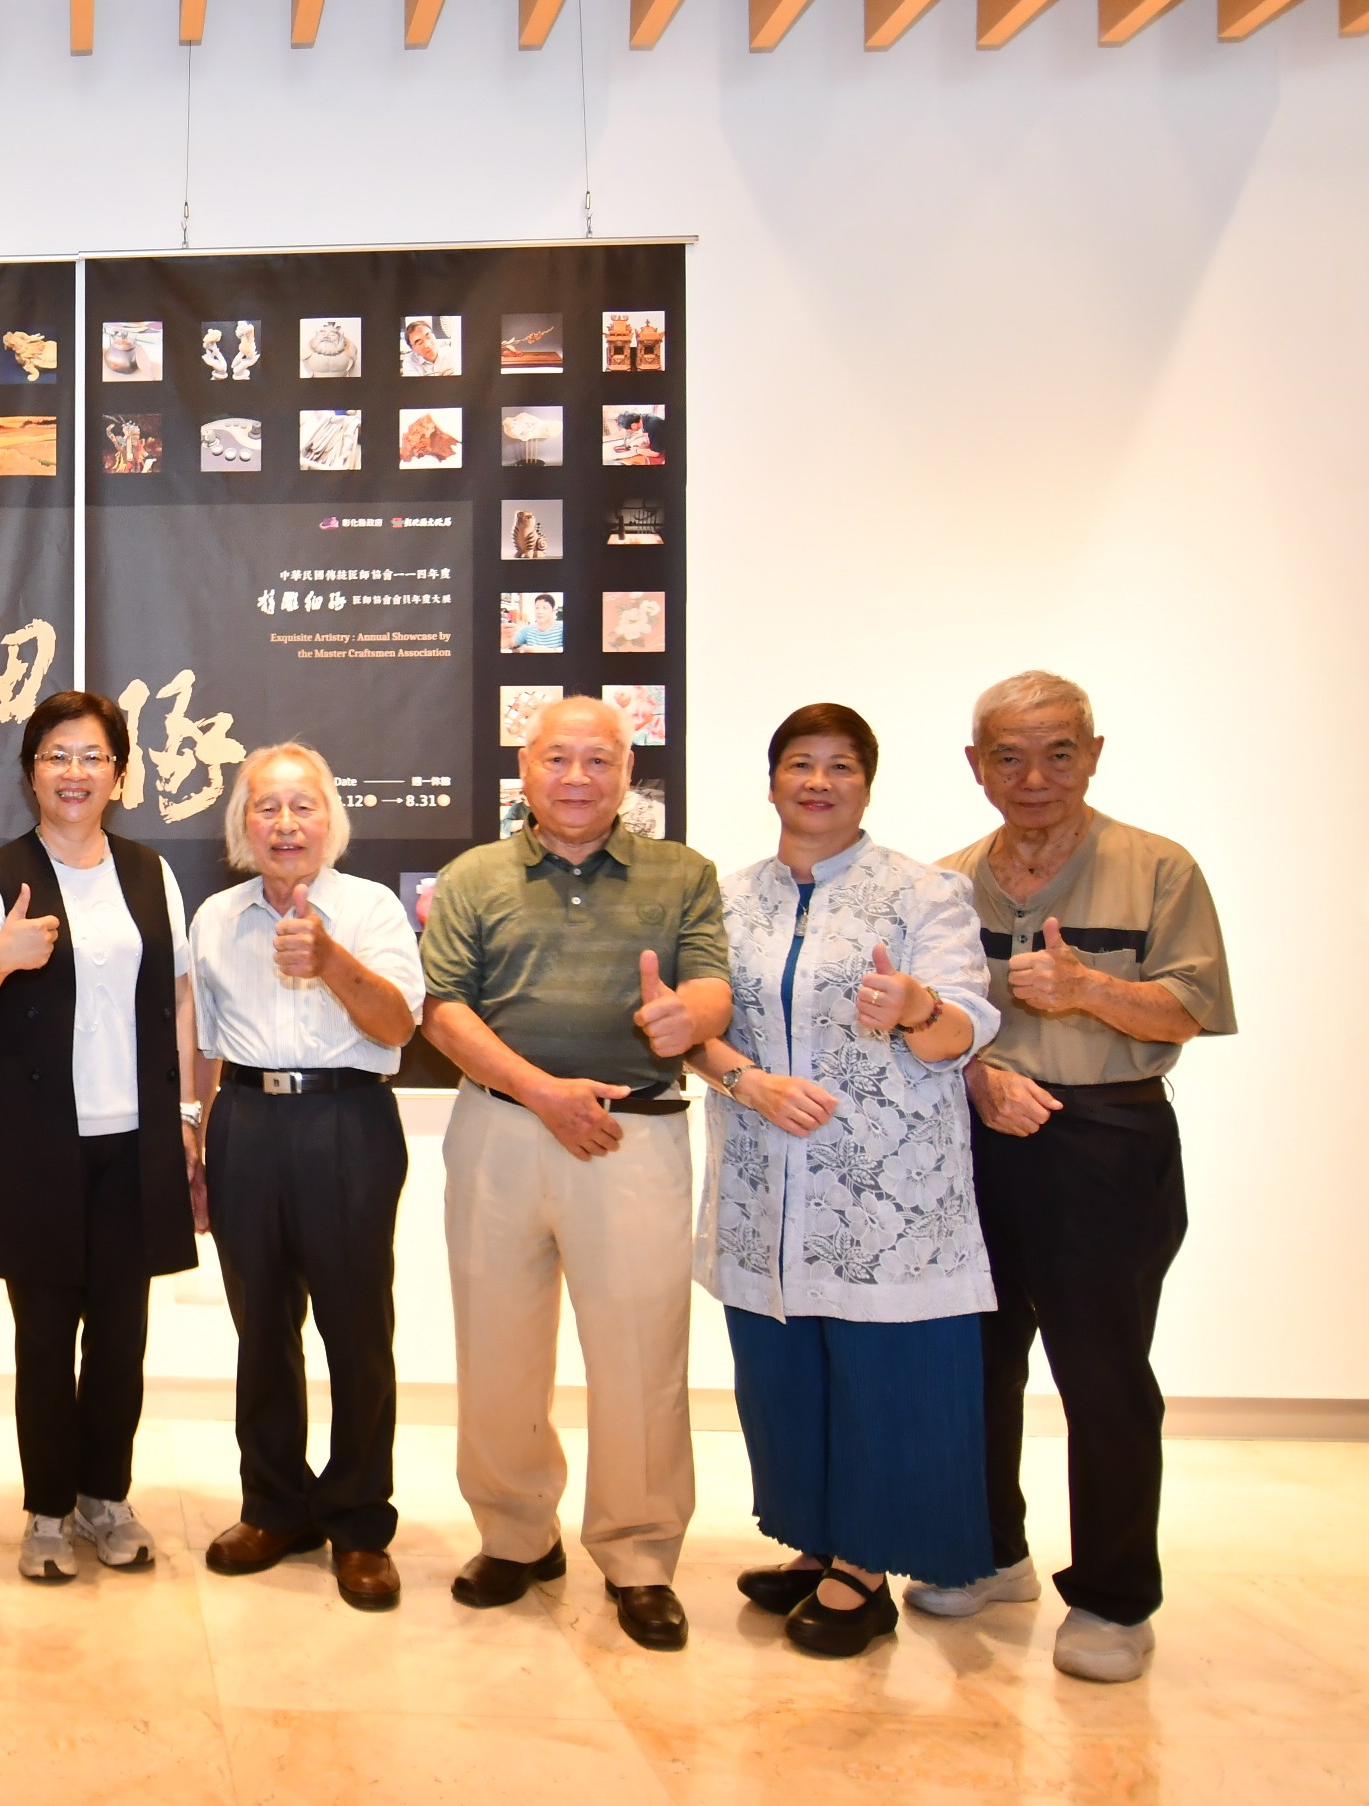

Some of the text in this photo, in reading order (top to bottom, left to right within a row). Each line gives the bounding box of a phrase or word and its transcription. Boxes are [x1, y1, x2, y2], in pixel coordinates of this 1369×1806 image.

[257, 588, 451, 615] 精雕細琢 匠師協會會員年度大展
[271, 634, 312, 643] Exquisite
[314, 633, 350, 643] Artistry
[358, 633, 390, 641] Annual
[392, 632, 437, 641] Showcase
[439, 632, 451, 642] by
[298, 649, 451, 657] the Master Craftsmen Association
[334, 776, 357, 787] Date
[339, 794, 363, 807] .12
[405, 794, 437, 807] 8.31
